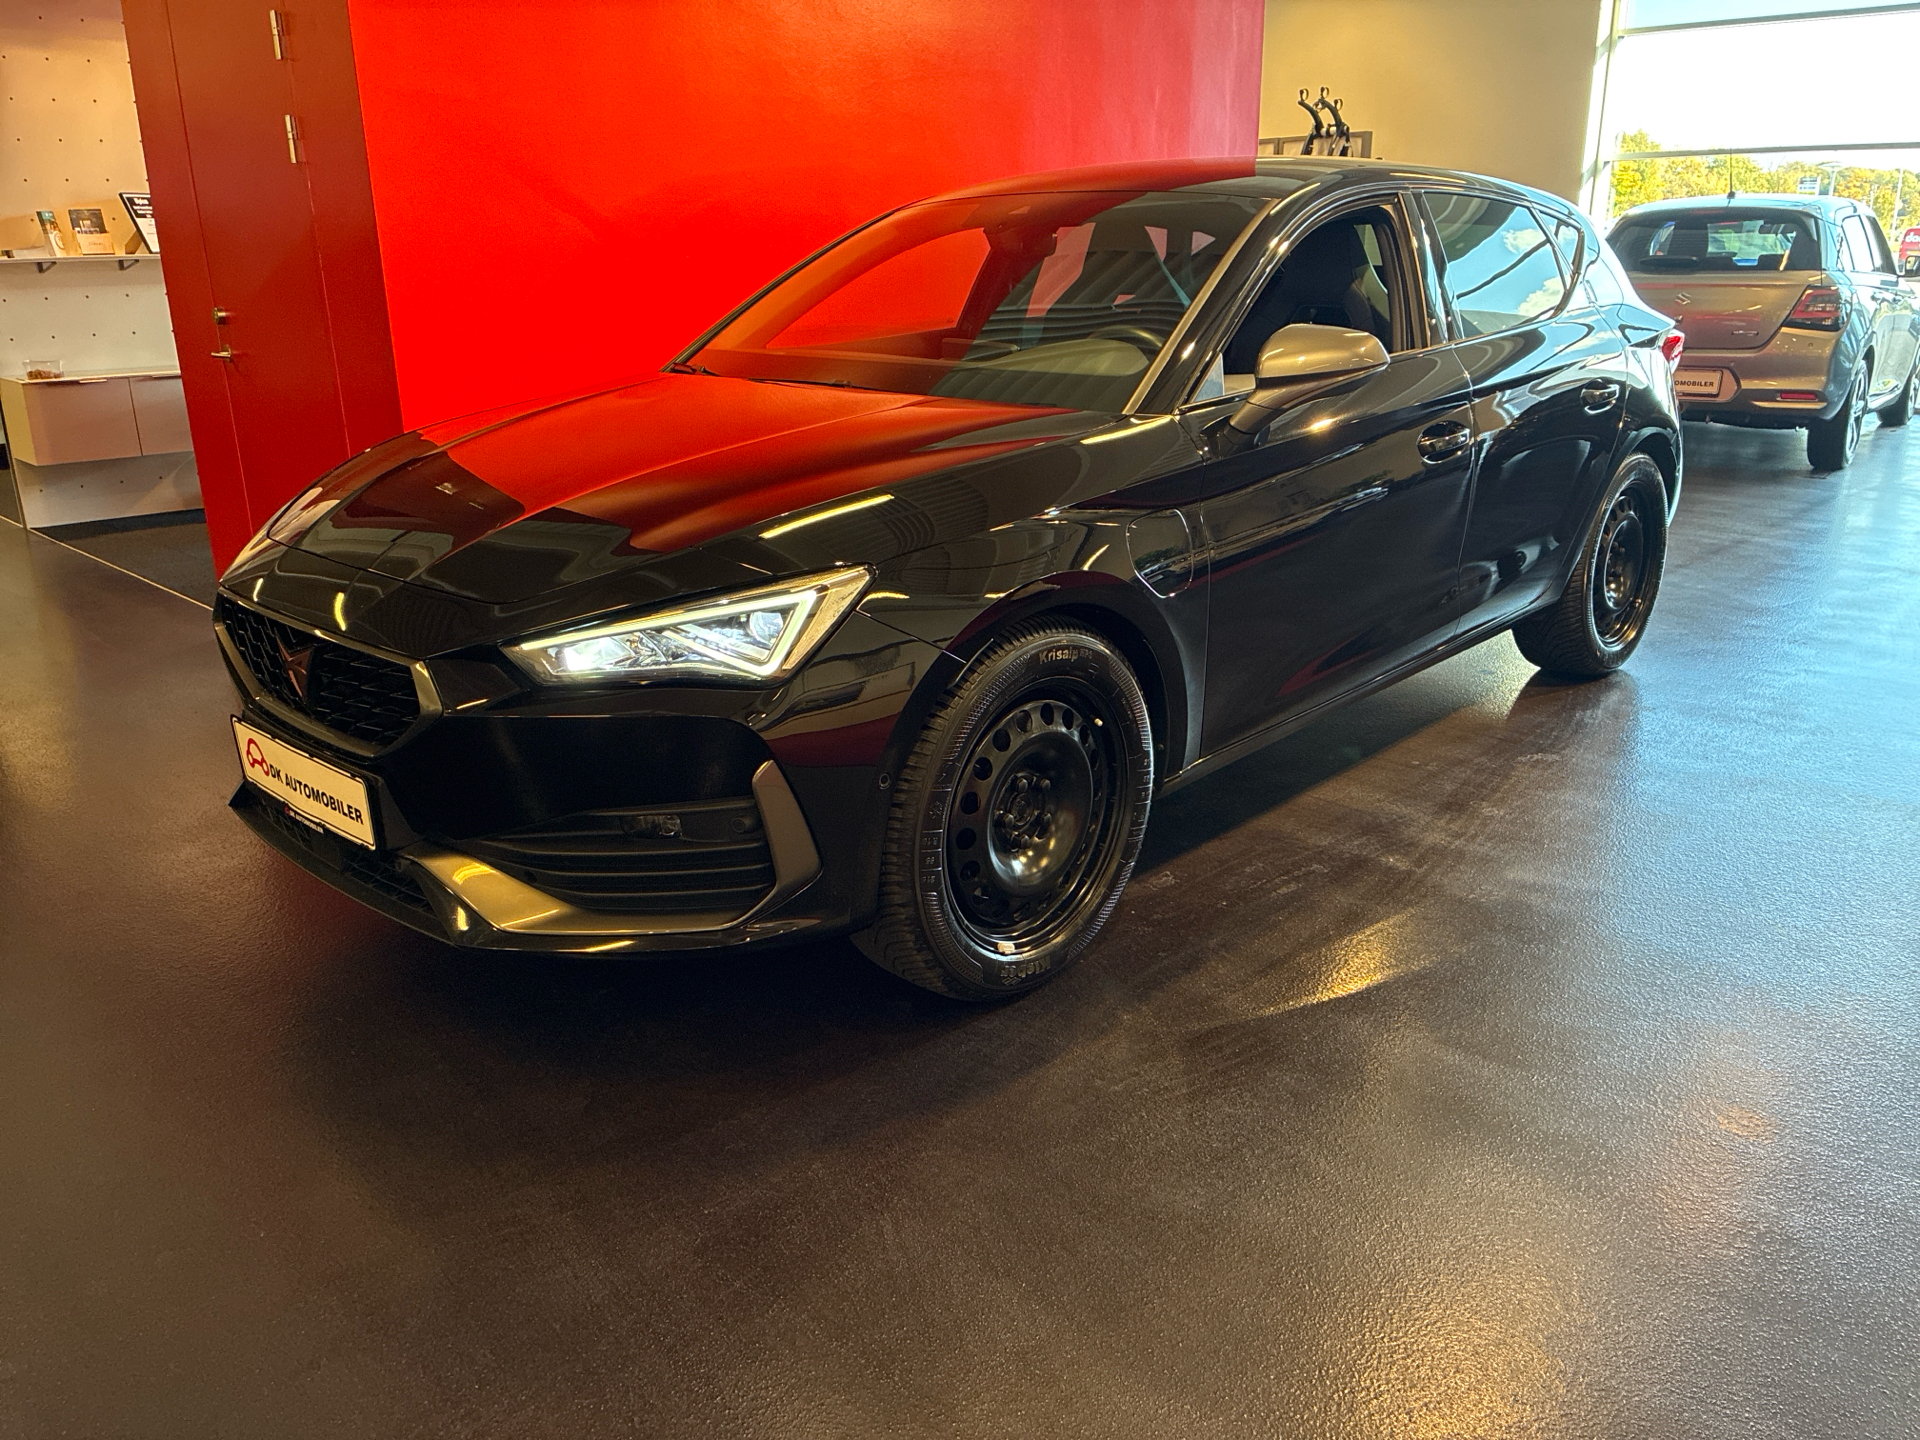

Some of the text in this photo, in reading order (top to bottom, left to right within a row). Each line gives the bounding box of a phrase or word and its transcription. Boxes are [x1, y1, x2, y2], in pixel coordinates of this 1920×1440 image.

[1039, 647, 1079, 664] Krisalp
[269, 764, 284, 784] DK
[285, 773, 363, 825] AUTOMOBILER
